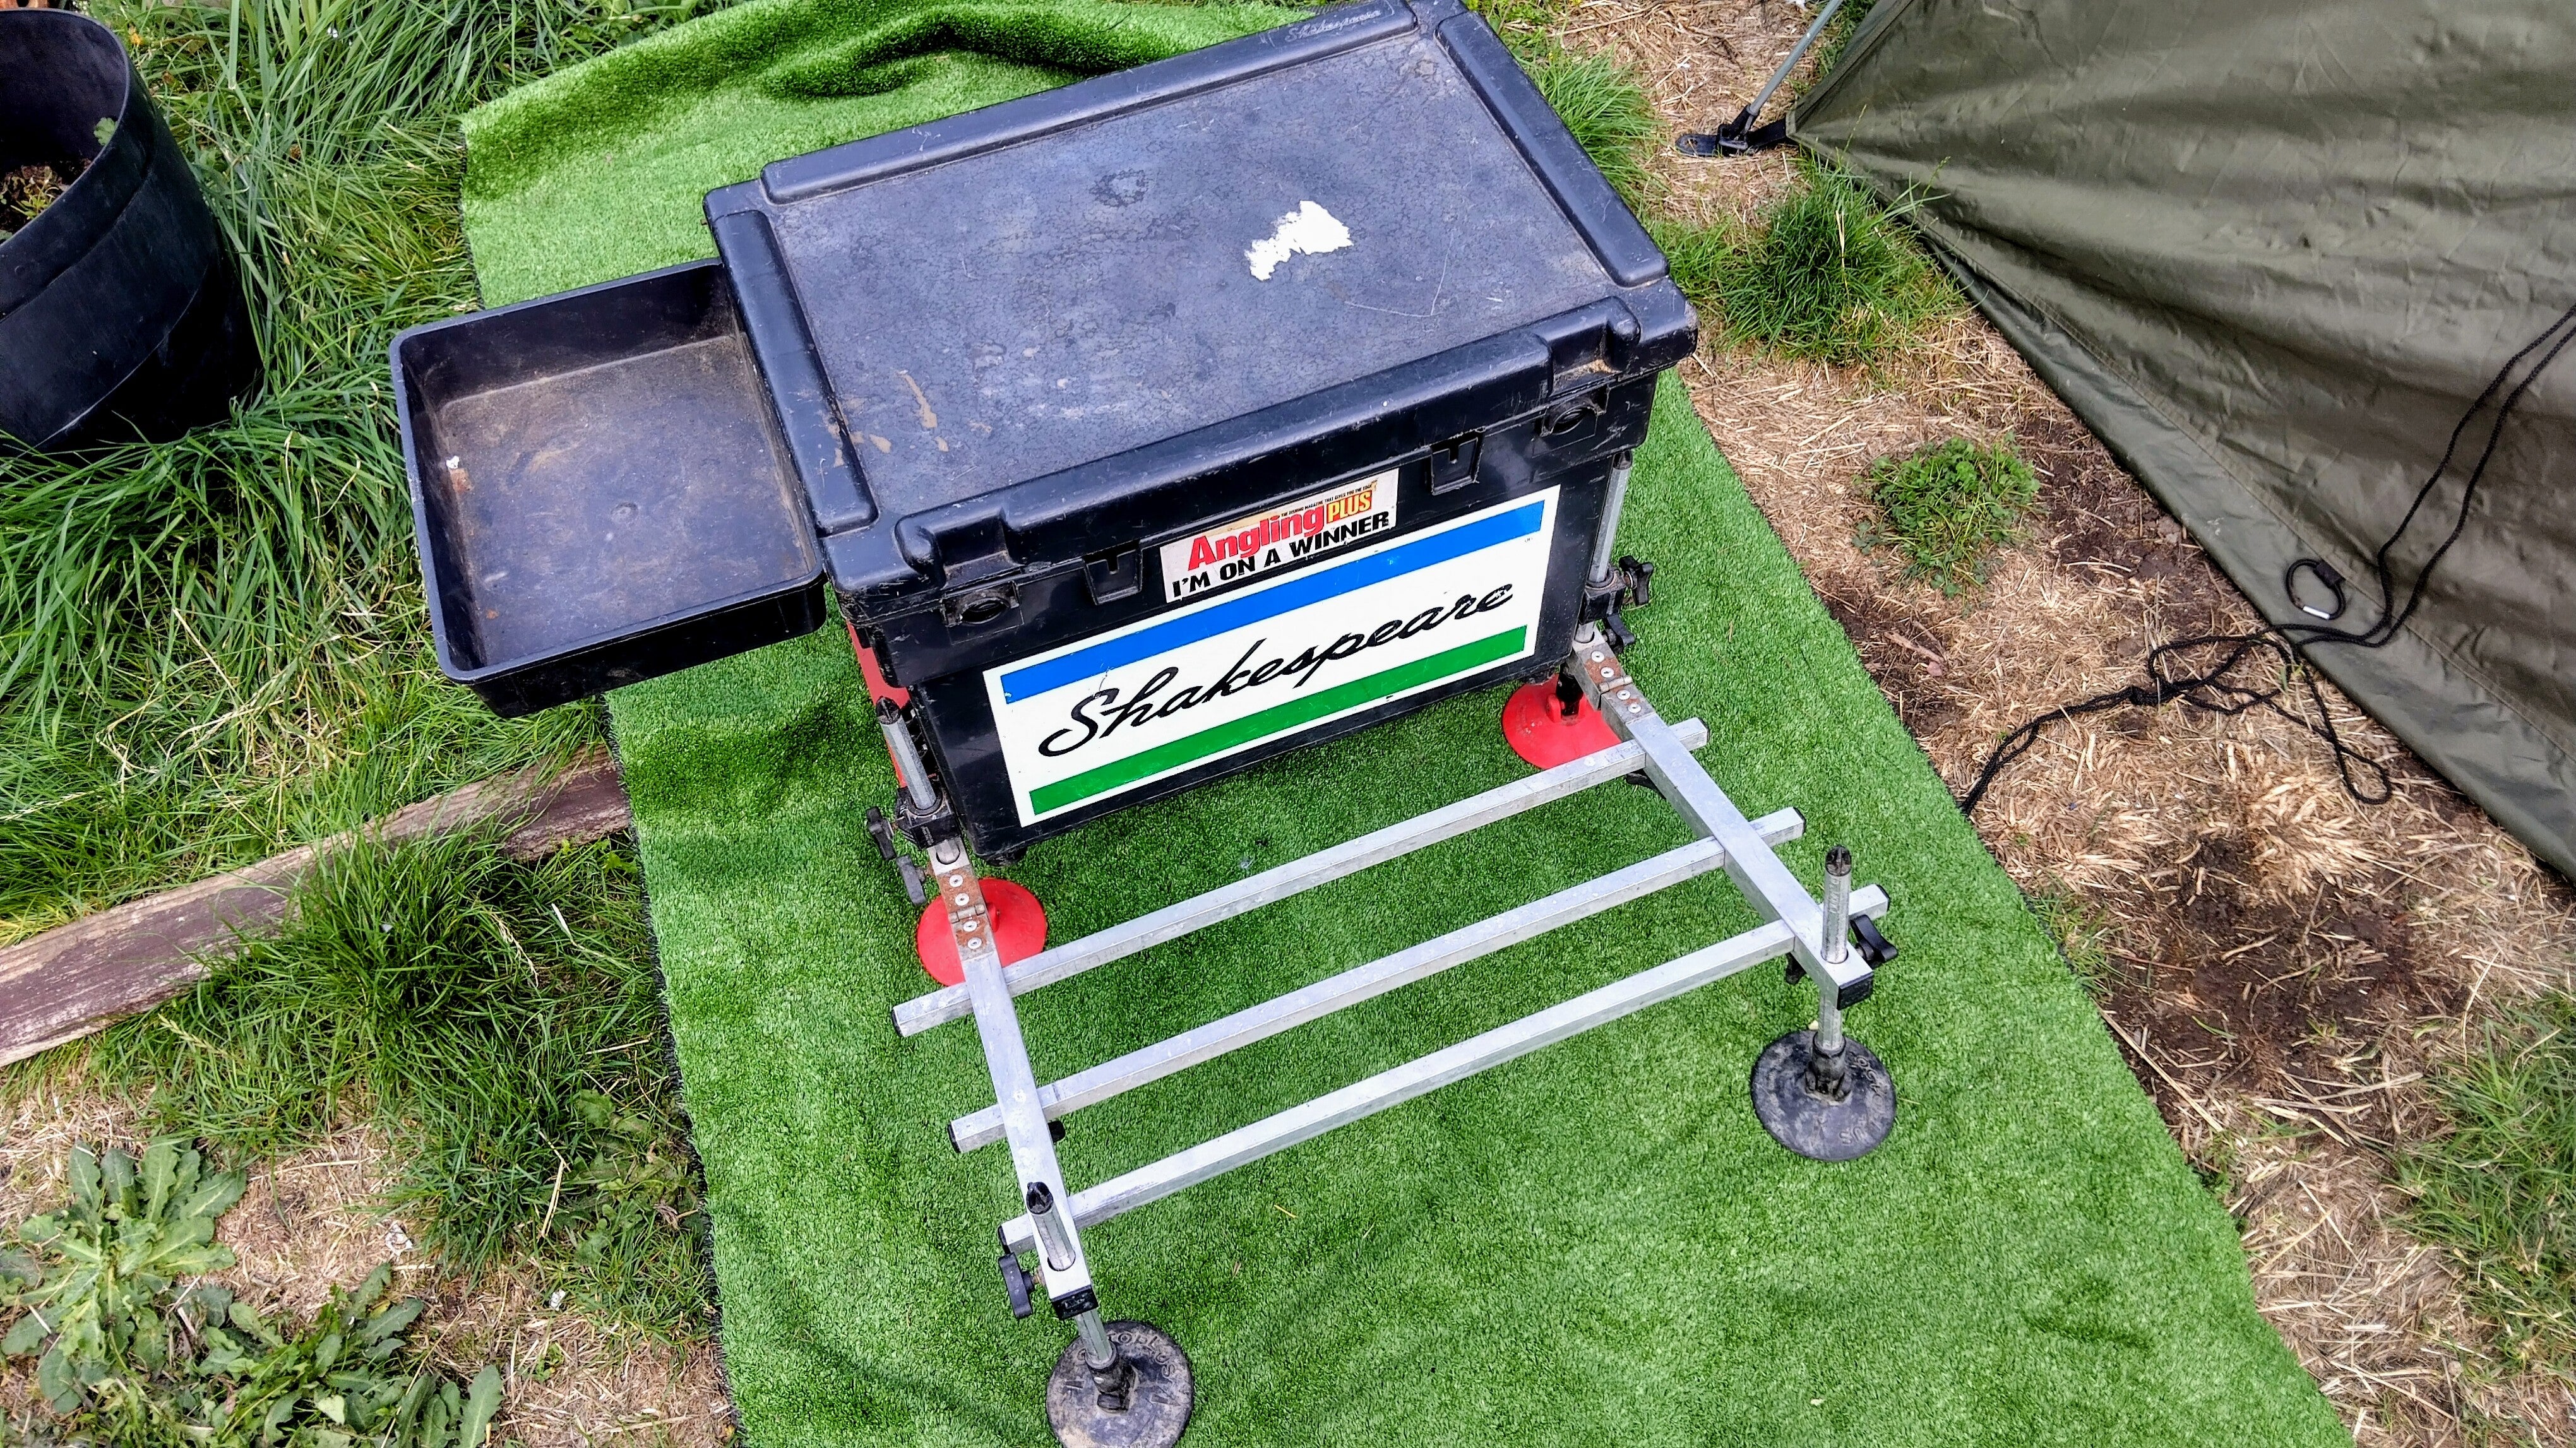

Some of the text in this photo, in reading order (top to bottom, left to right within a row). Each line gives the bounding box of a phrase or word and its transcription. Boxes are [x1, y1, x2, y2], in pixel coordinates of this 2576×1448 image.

[1188, 491, 1371, 571] Angling PLUS
[1304, 500, 1323, 510] MAGAZINE
[1172, 511, 1389, 597] I'M ON A WINNER
[1039, 584, 1513, 757] Shakespeare
